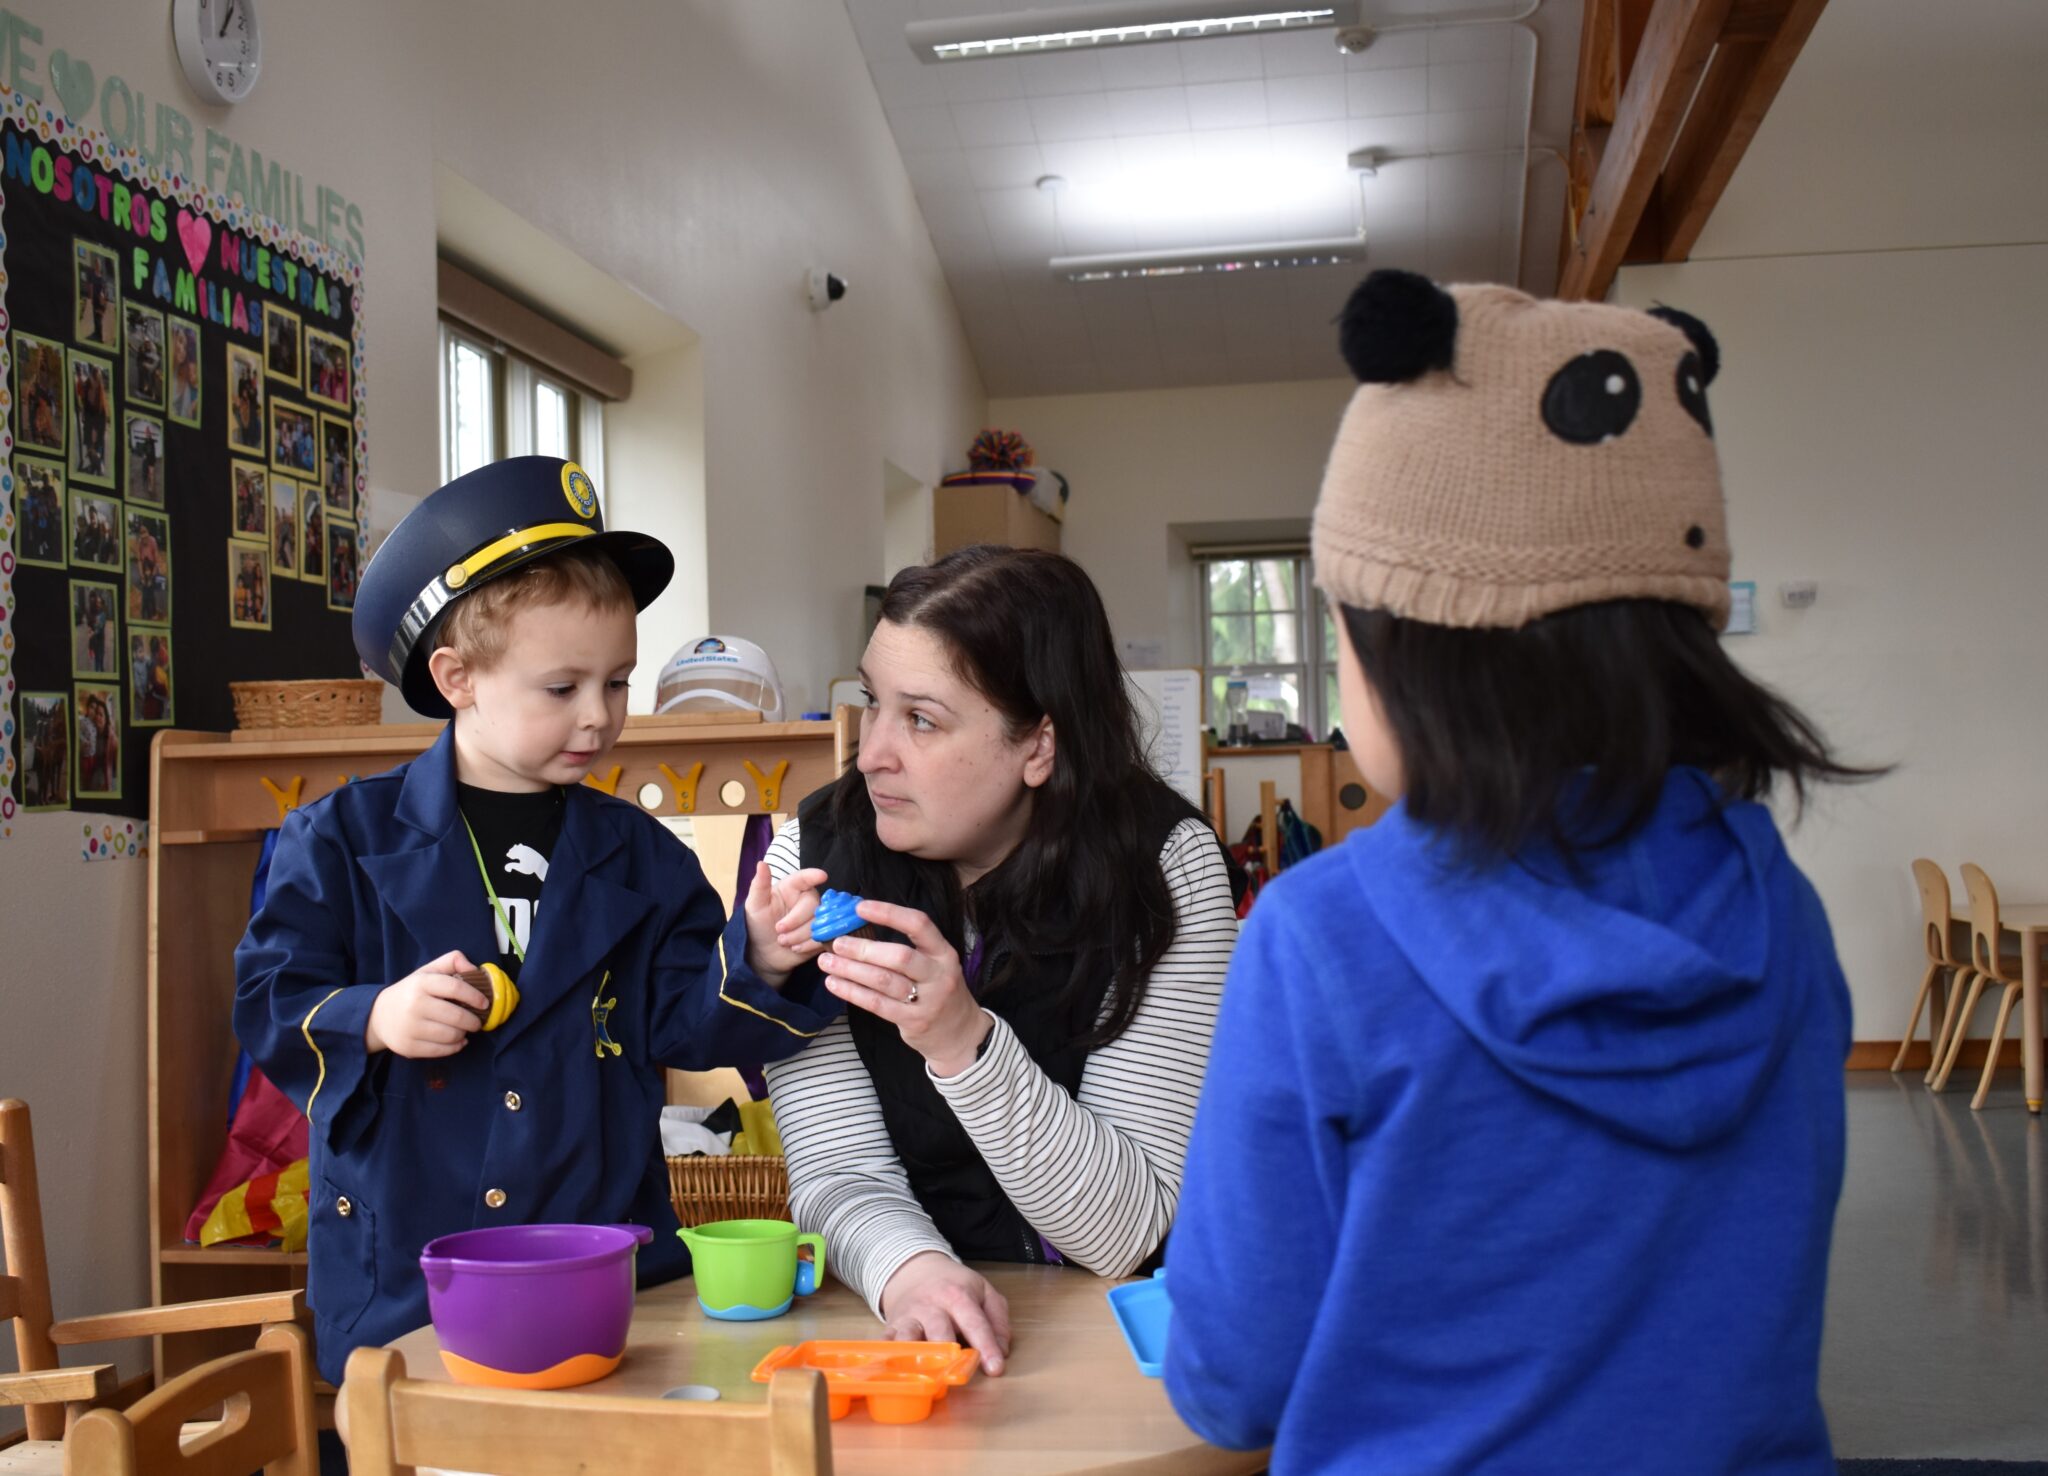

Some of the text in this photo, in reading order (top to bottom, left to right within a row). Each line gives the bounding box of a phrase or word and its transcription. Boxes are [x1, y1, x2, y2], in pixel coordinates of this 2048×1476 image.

[0, 9, 365, 265] E OUR FAMILIES
[6, 131, 341, 319] NOSOTROS NUESTRAS
[133, 246, 262, 337] FAMILIAS
